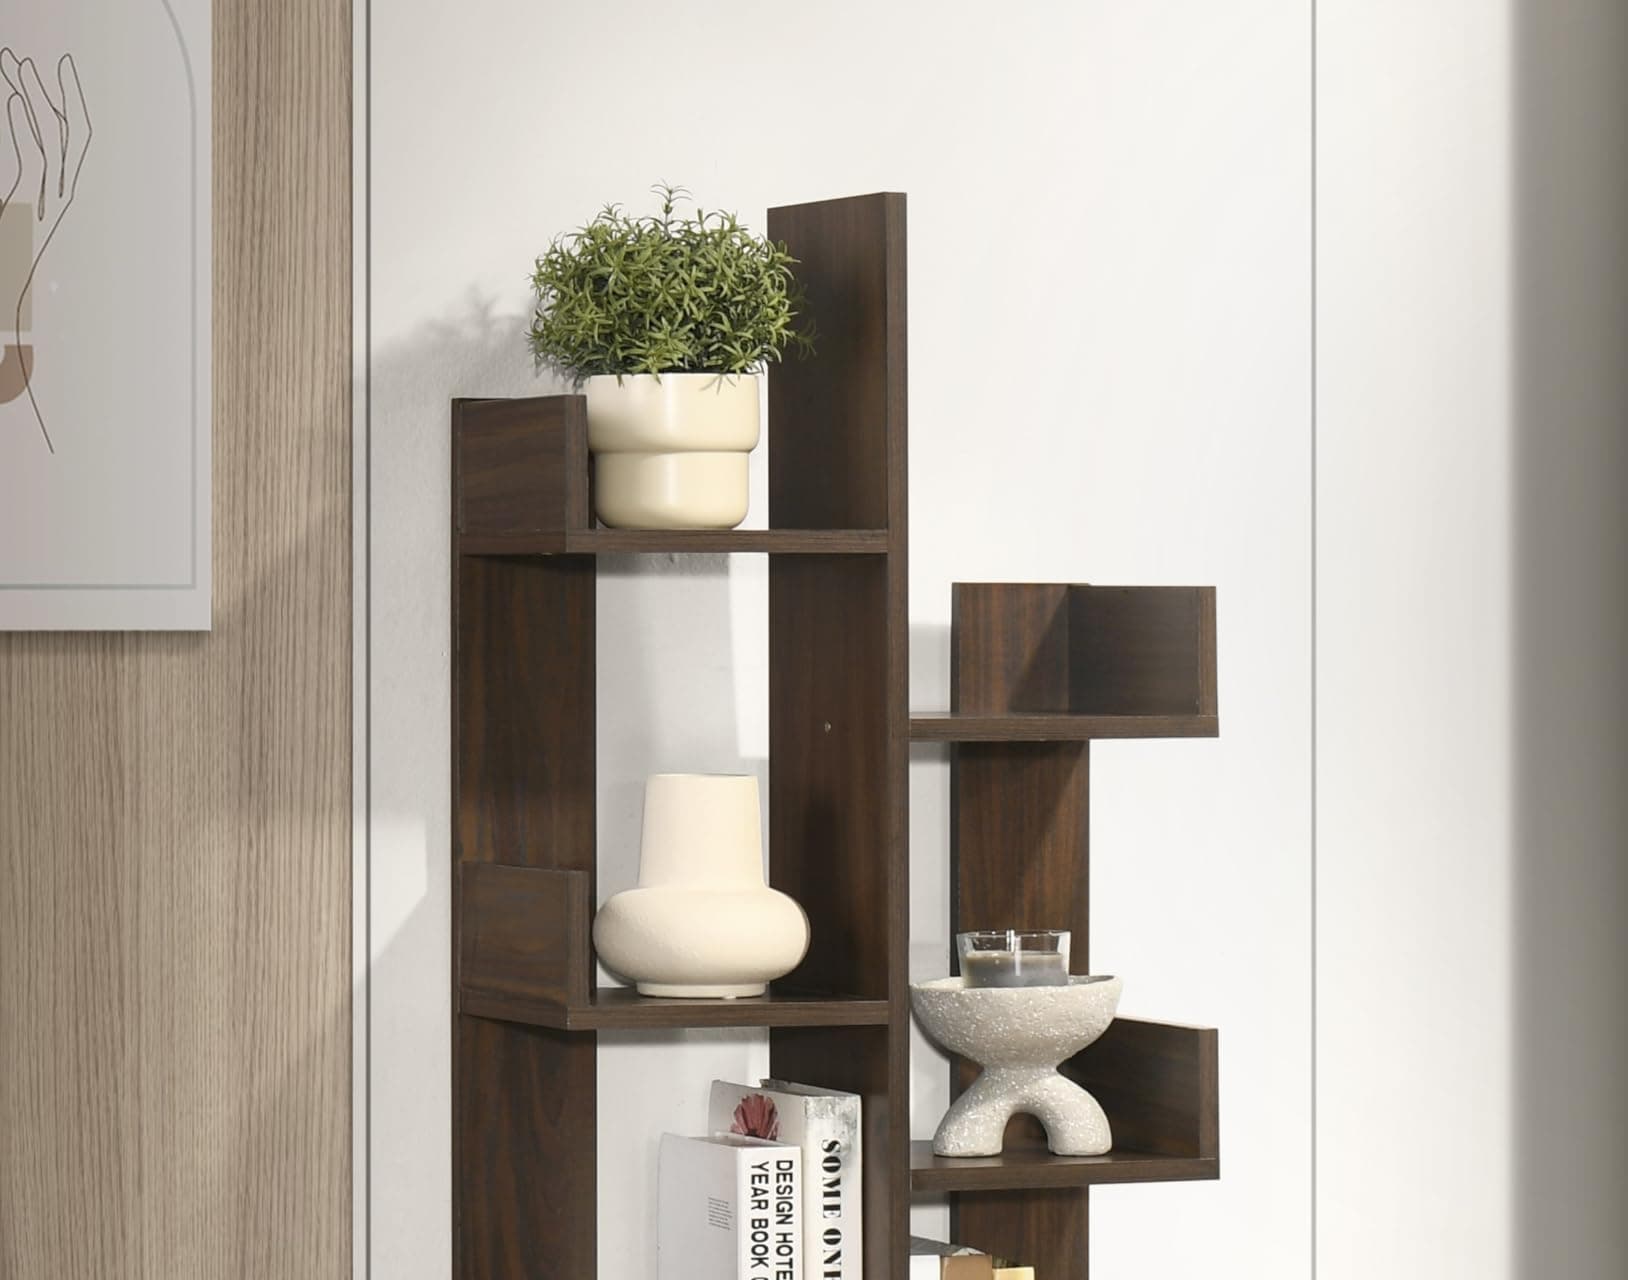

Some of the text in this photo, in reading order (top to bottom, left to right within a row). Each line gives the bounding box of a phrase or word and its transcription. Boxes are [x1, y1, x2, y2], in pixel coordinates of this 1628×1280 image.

[750, 1160, 770, 1210] YEAR
[775, 1159, 794, 1225] DESIGN
[821, 1138, 842, 1219] SOME
[750, 1218, 770, 1269] BOOK
